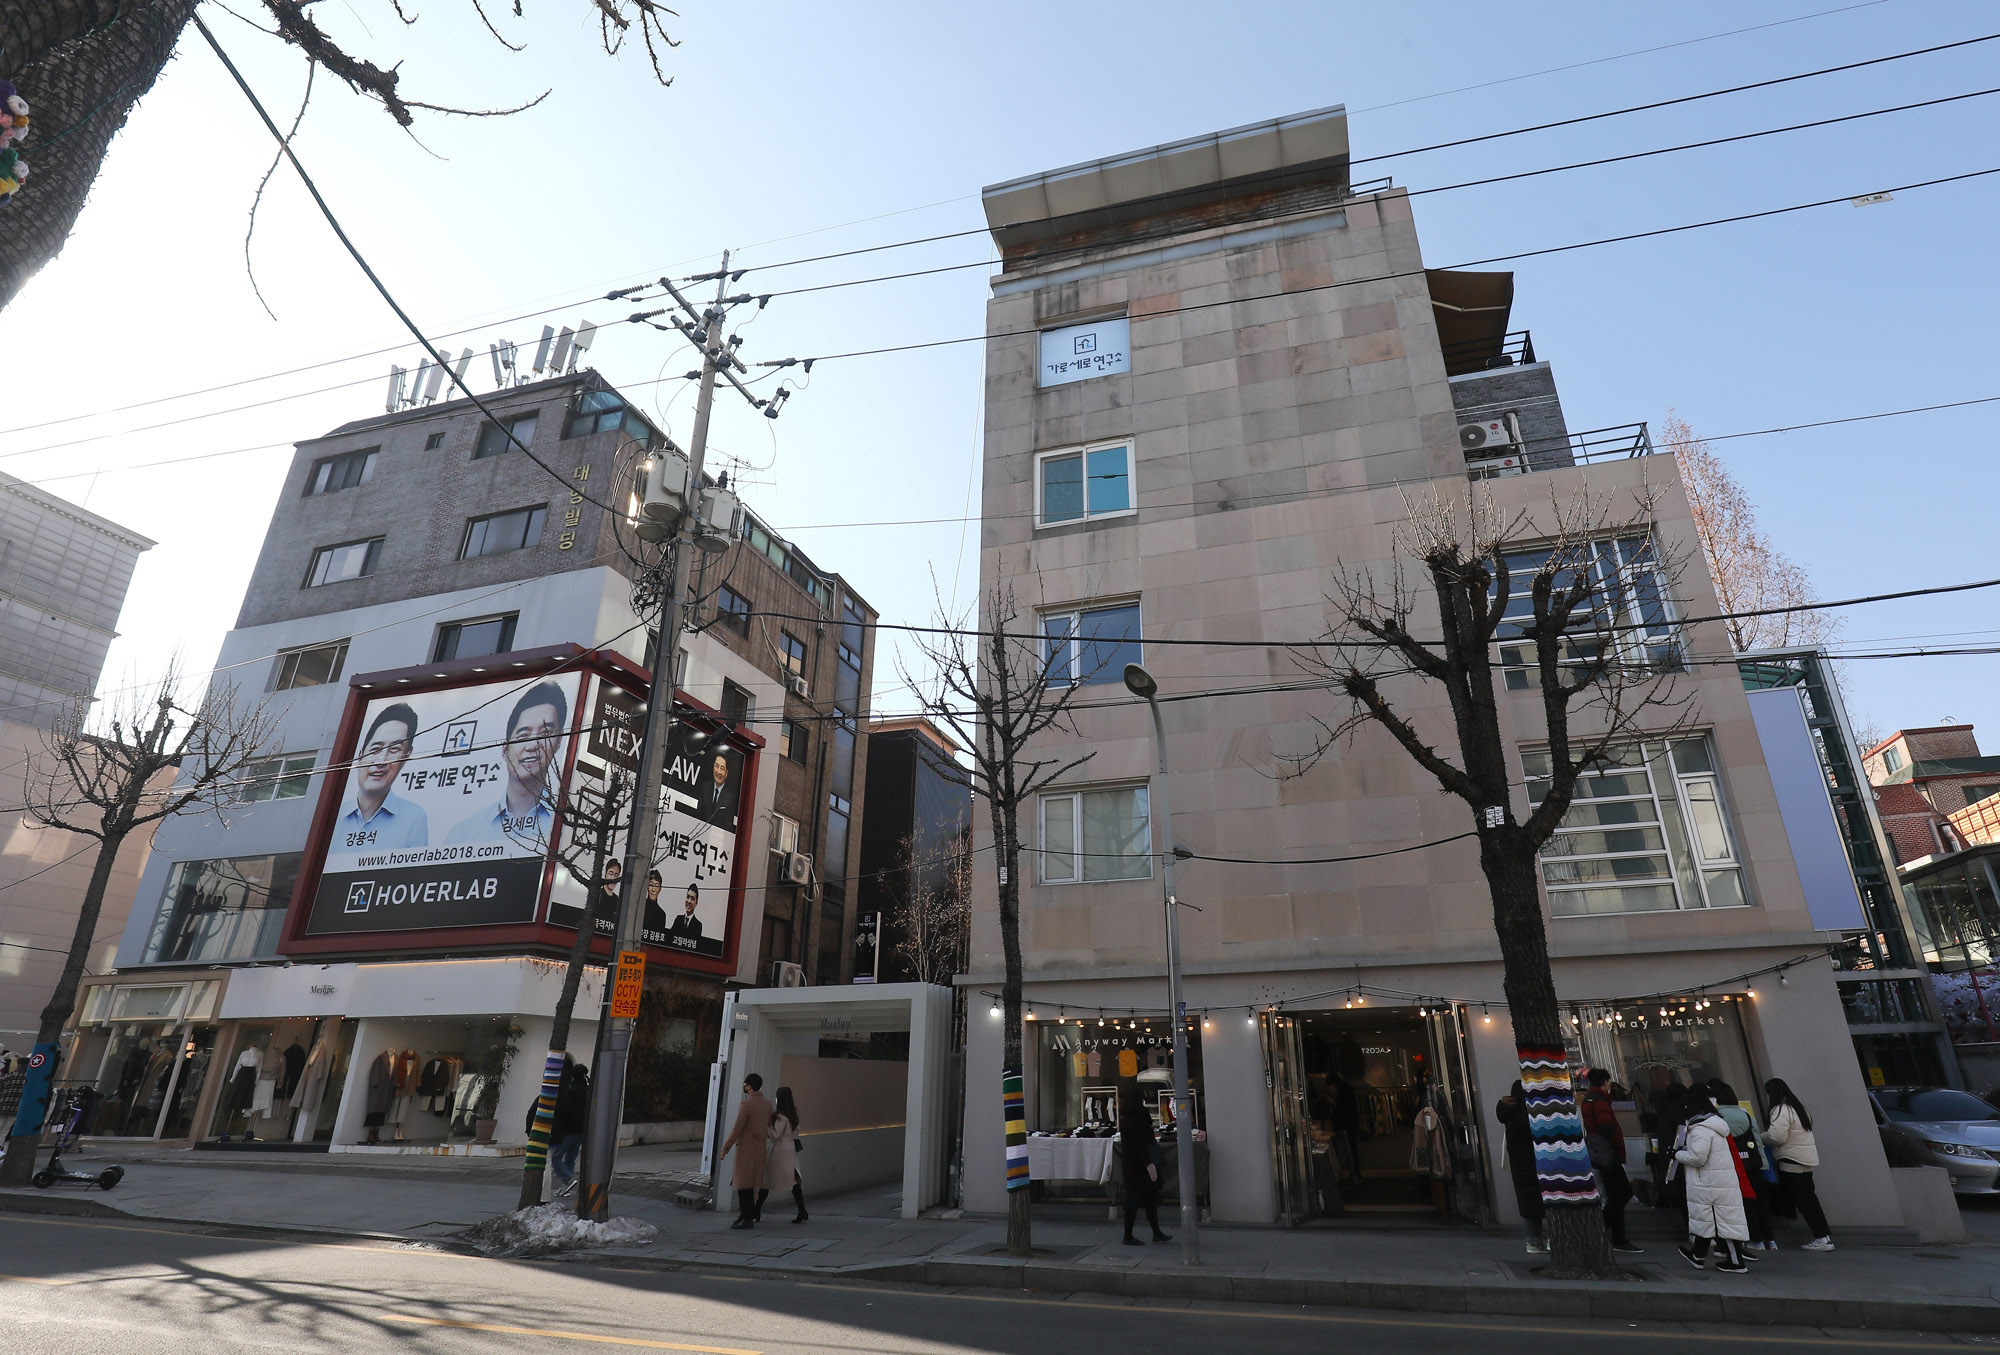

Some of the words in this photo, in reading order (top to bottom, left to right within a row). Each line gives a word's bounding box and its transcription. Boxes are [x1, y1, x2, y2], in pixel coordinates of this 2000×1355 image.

[559, 463, 591, 551] 대영빌딩
[502, 815, 537, 833] 김세의
[345, 830, 378, 848] 강용석
[357, 844, 504, 867] www.hoverlab2018.com
[375, 877, 498, 906] HOVERLAB
[649, 930, 666, 942] 김용호
[616, 984, 640, 998] CCTV
[614, 999, 637, 1015] 단속중
[1660, 1015, 1725, 1027] Market
[1074, 1037, 1128, 1047] Anyway
